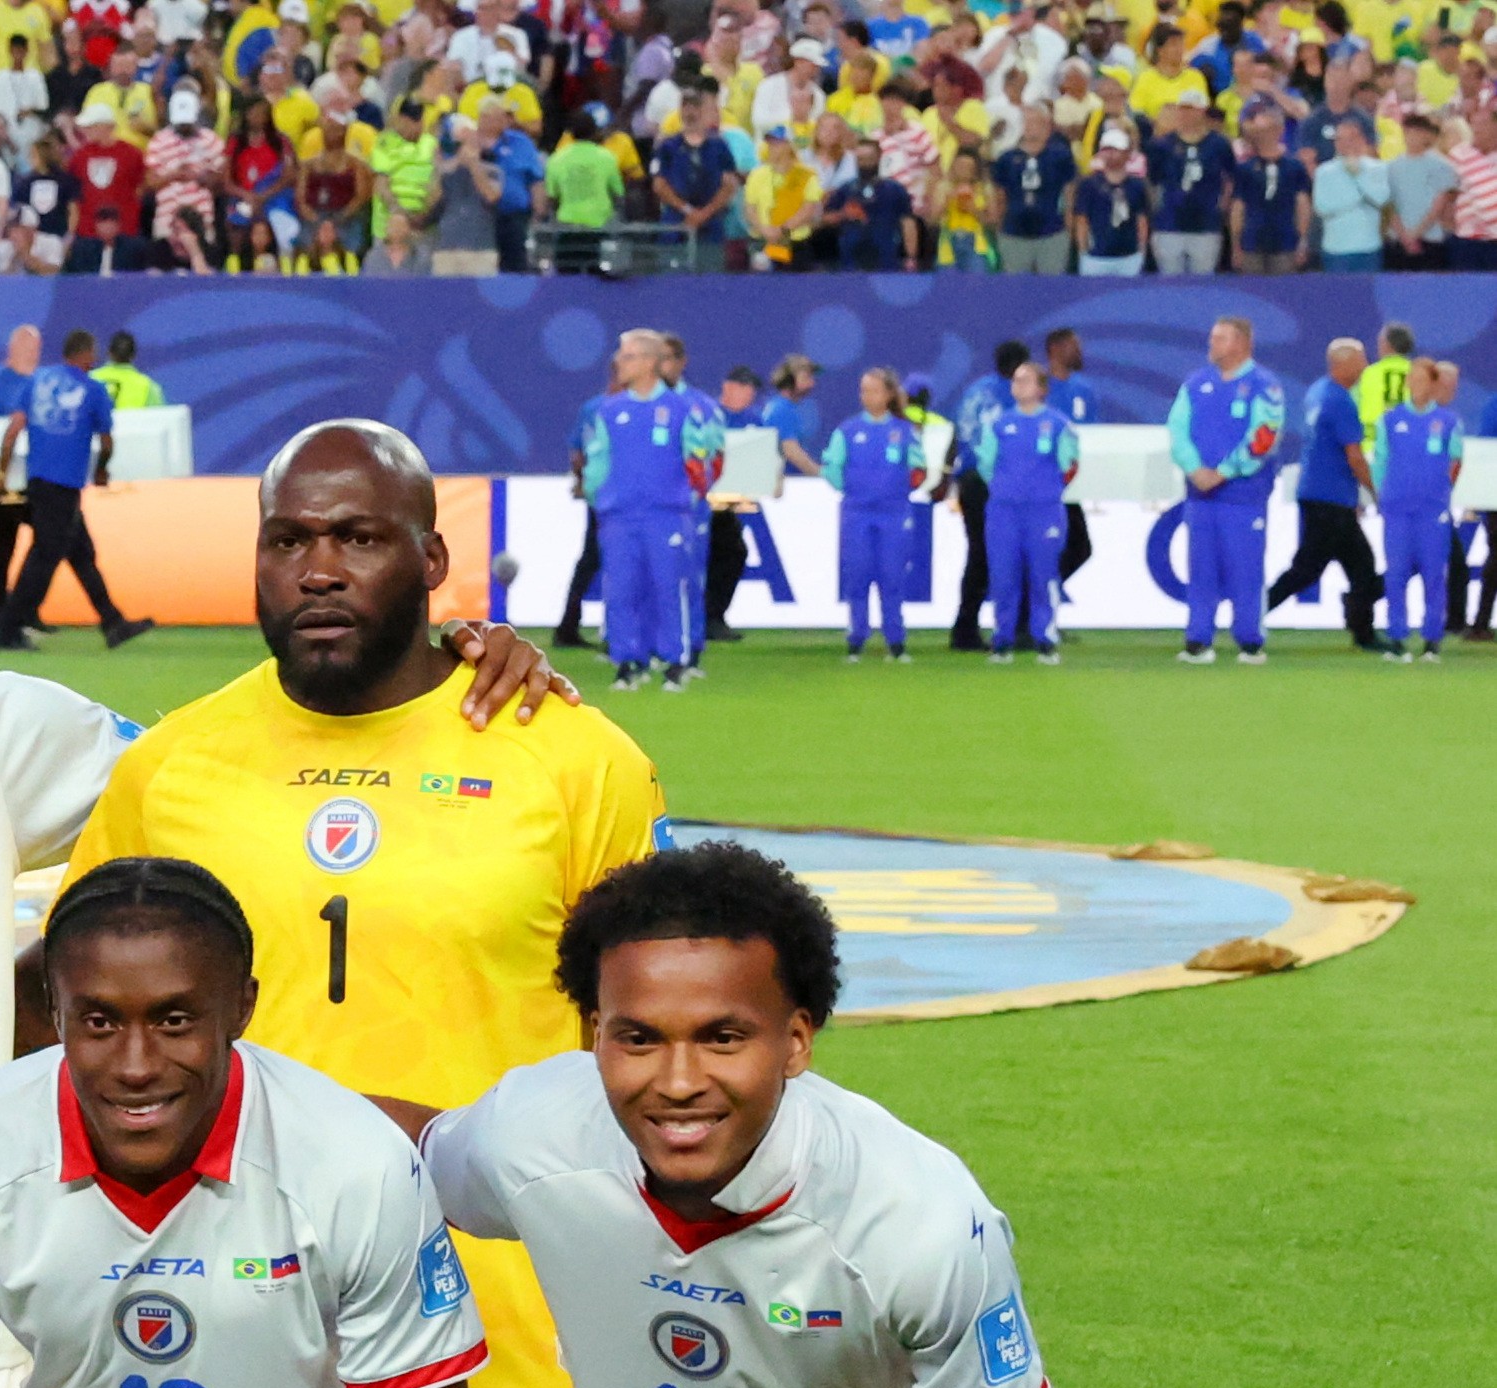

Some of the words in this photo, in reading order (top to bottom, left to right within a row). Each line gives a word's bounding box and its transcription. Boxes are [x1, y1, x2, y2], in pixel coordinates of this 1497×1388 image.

[286, 768, 391, 787] SAETA
[329, 814, 357, 823] HAITI
[319, 894, 348, 1004] 1
[99, 1258, 205, 1280] SAETA
[640, 1274, 746, 1305] SAETA
